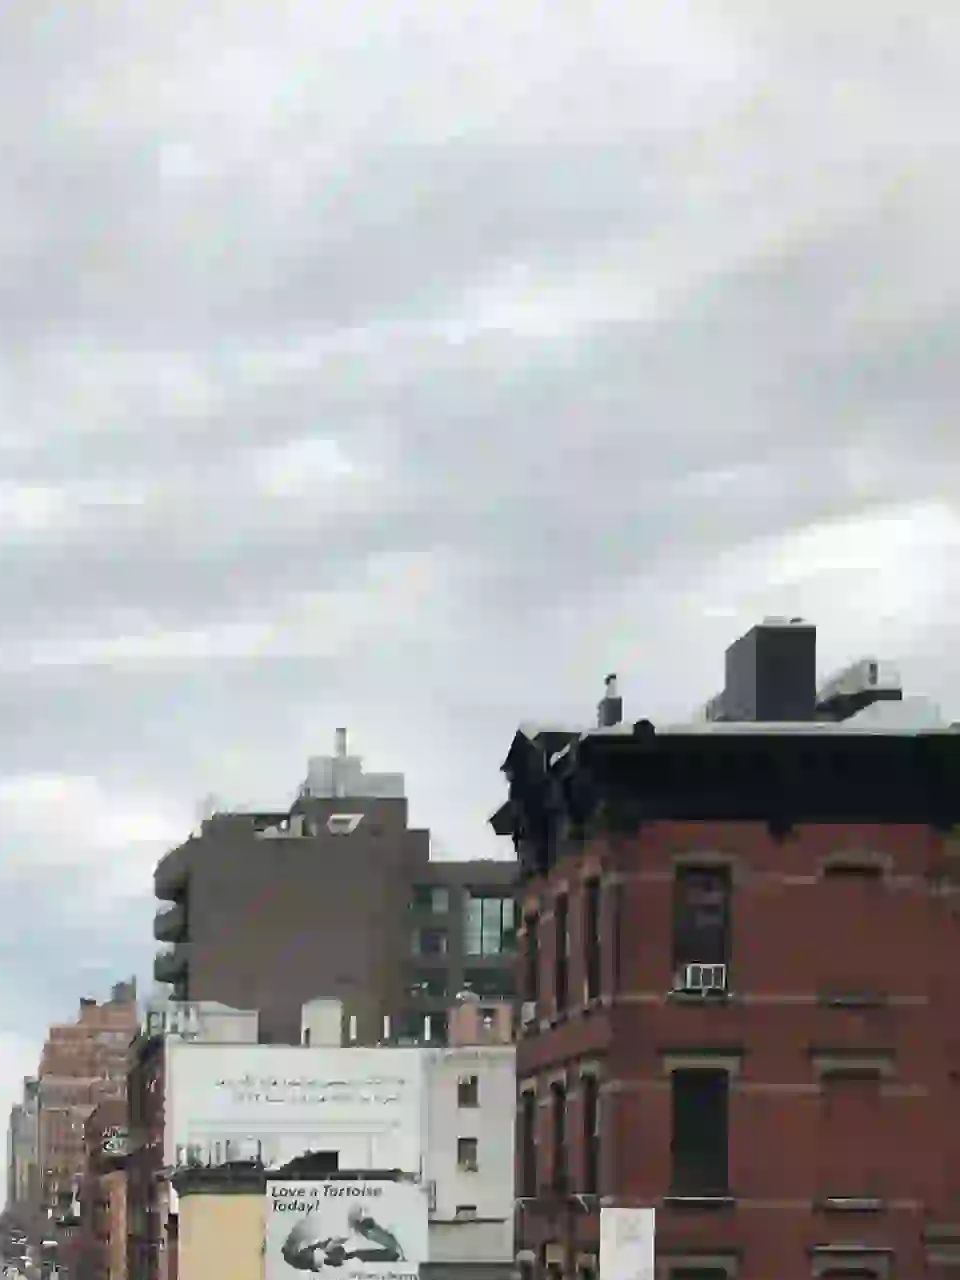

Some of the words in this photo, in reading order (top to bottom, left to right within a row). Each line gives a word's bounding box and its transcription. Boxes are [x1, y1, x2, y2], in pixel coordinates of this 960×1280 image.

[271, 1185, 305, 1198] Love
[323, 1184, 382, 1197] Tortoise
[272, 1199, 320, 1215] Today!
